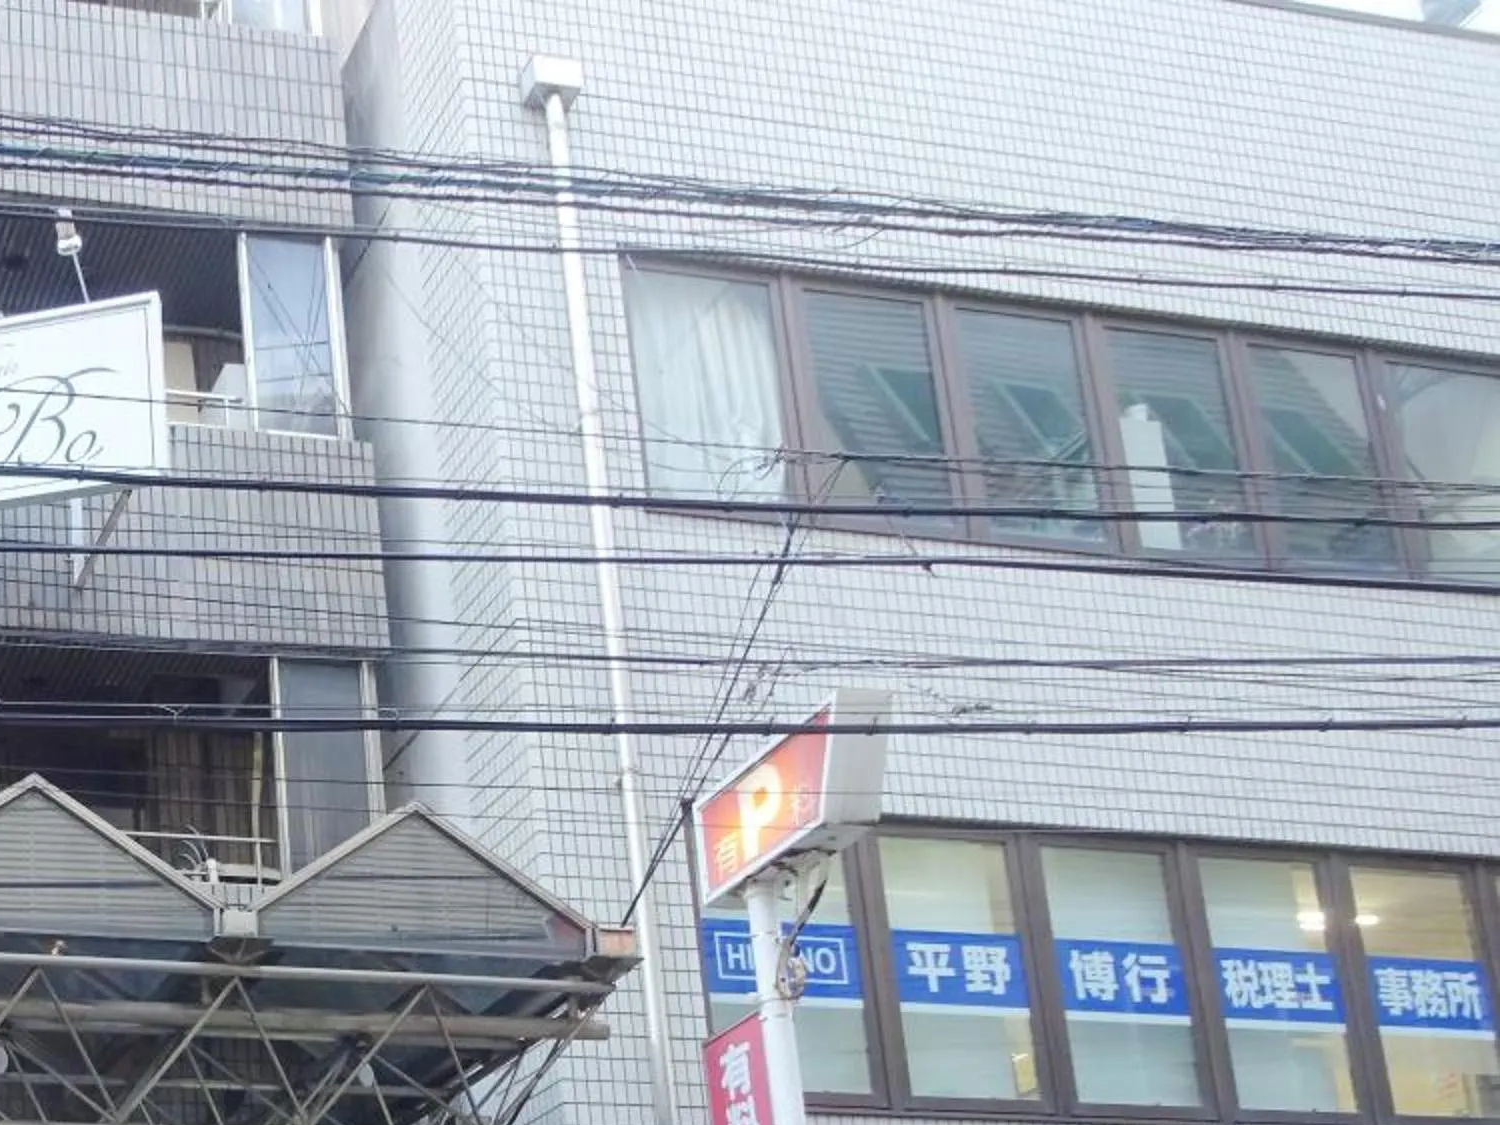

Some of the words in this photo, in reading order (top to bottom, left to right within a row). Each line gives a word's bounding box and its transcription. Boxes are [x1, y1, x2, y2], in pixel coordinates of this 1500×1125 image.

[737, 764, 782, 863] P
[726, 943, 837, 975] HINO
[907, 942, 1012, 996] 平野
[1068, 949, 1170, 1004] 博行
[1222, 960, 1334, 1012] 税理士
[1376, 969, 1483, 1020] 事務所
